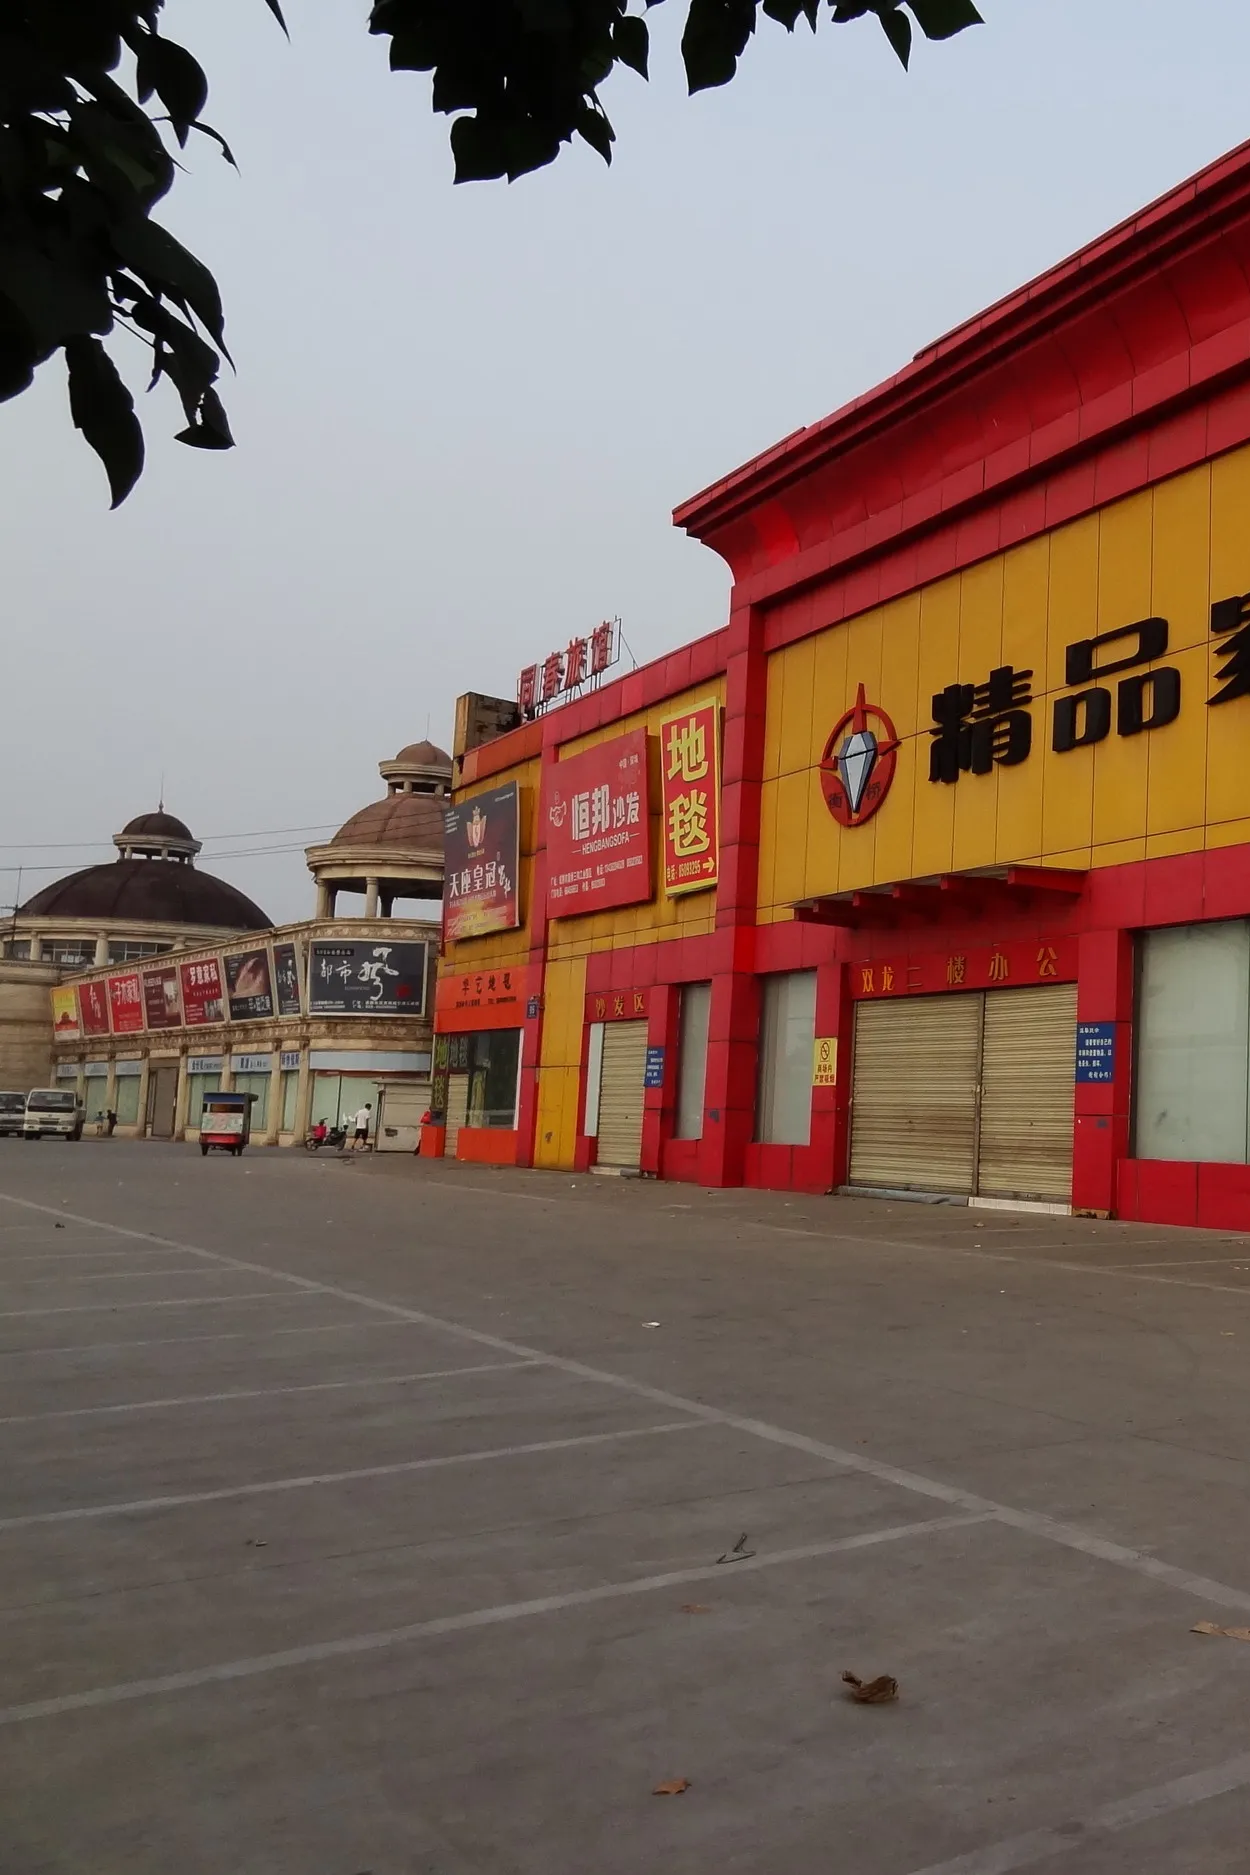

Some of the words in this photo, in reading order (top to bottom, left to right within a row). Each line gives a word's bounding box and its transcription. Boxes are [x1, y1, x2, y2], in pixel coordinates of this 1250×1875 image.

[667, 717, 711, 857] 地毯
[572, 784, 640, 841] 恒邦沙发
[582, 831, 631, 855] HENGBANGSOFA
[861, 947, 1058, 992] 双龙二楼办公
[595, 993, 645, 1018] 沙发区
